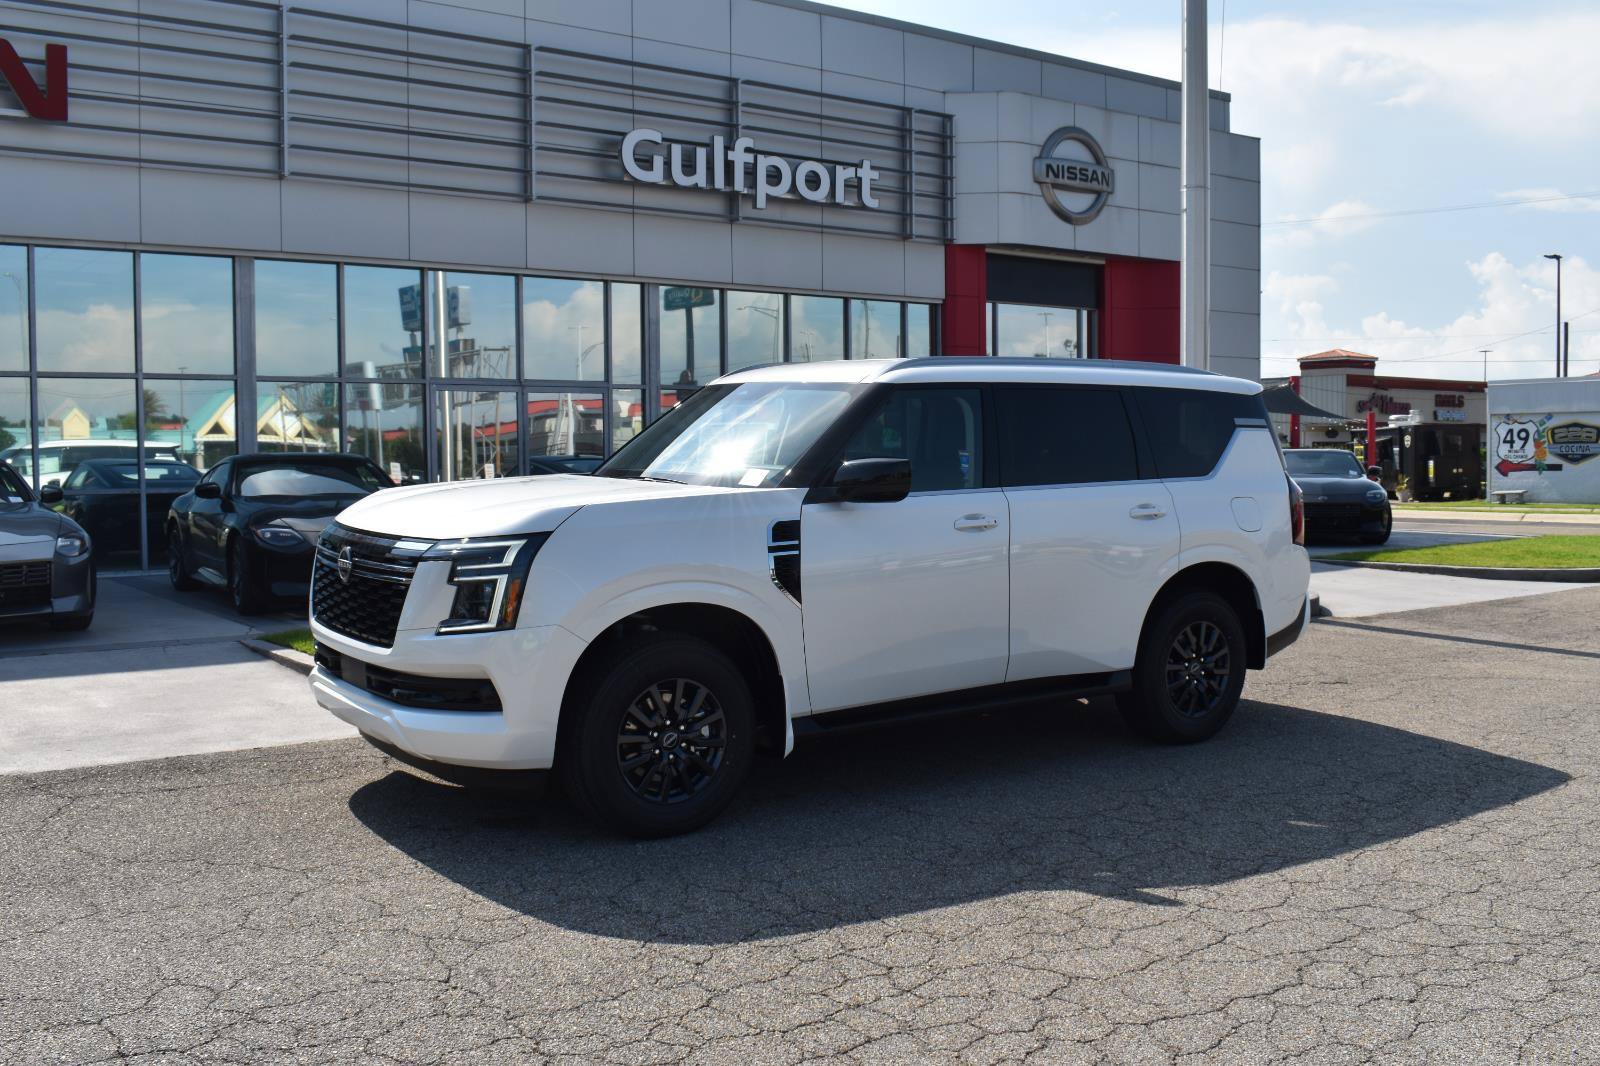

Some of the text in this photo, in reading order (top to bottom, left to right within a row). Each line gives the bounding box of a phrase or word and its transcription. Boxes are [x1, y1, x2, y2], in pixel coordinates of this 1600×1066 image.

[620, 128, 881, 209] Gulfport
[1045, 163, 1110, 187] NISSAN
[1502, 428, 1530, 449] 49
[1559, 445, 1591, 453] COCINA
